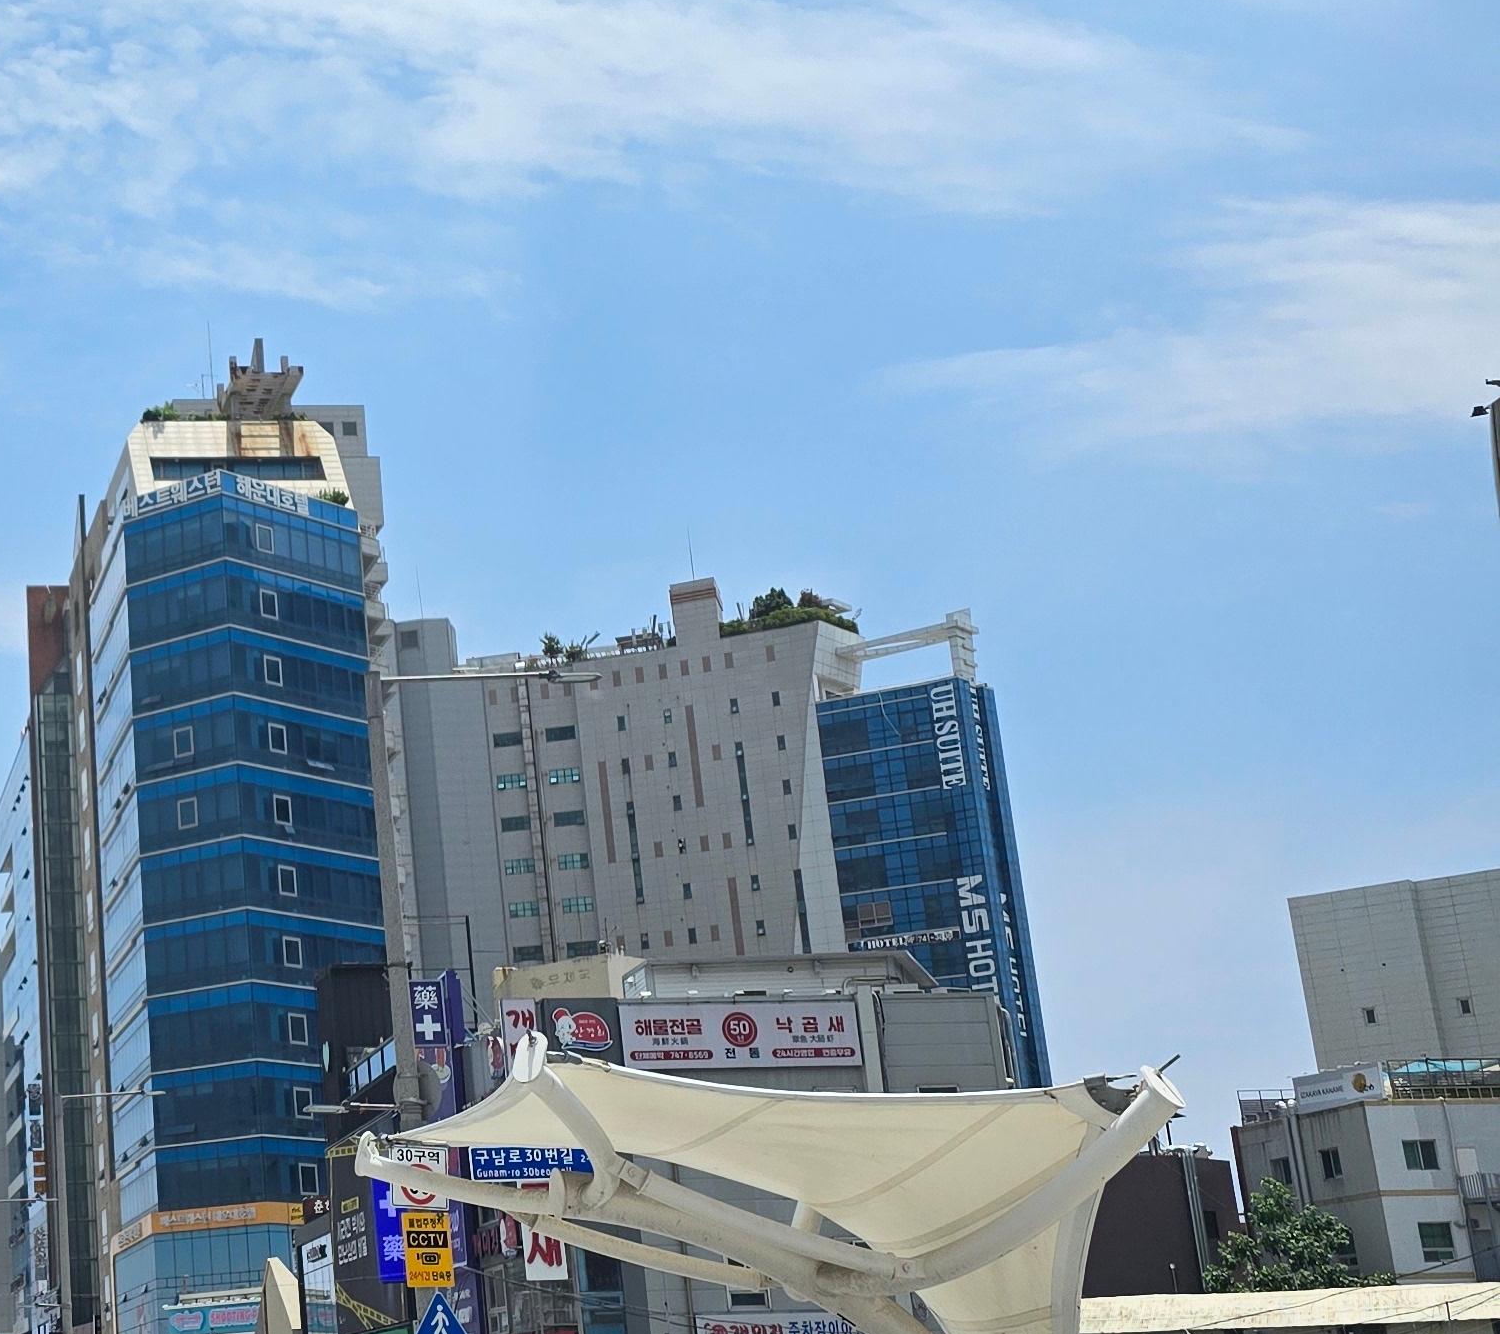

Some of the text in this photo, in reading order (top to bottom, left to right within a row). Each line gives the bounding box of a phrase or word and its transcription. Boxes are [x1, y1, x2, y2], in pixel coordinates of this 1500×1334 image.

[122, 471, 221, 517] 베스트웨스턴
[236, 474, 310, 516] 해운대호텔
[930, 684, 967, 790] UH SUITE
[956, 874, 1000, 1003] MS HOT
[413, 985, 439, 1010] 藥
[634, 1018, 703, 1036] 해물전골
[729, 1020, 750, 1035] 50
[396, 1148, 441, 1165] 30구역
[408, 1217, 445, 1229] 불법주정차
[409, 1233, 445, 1247] CCTV
[409, 1270, 452, 1281] 24시간 단속중
